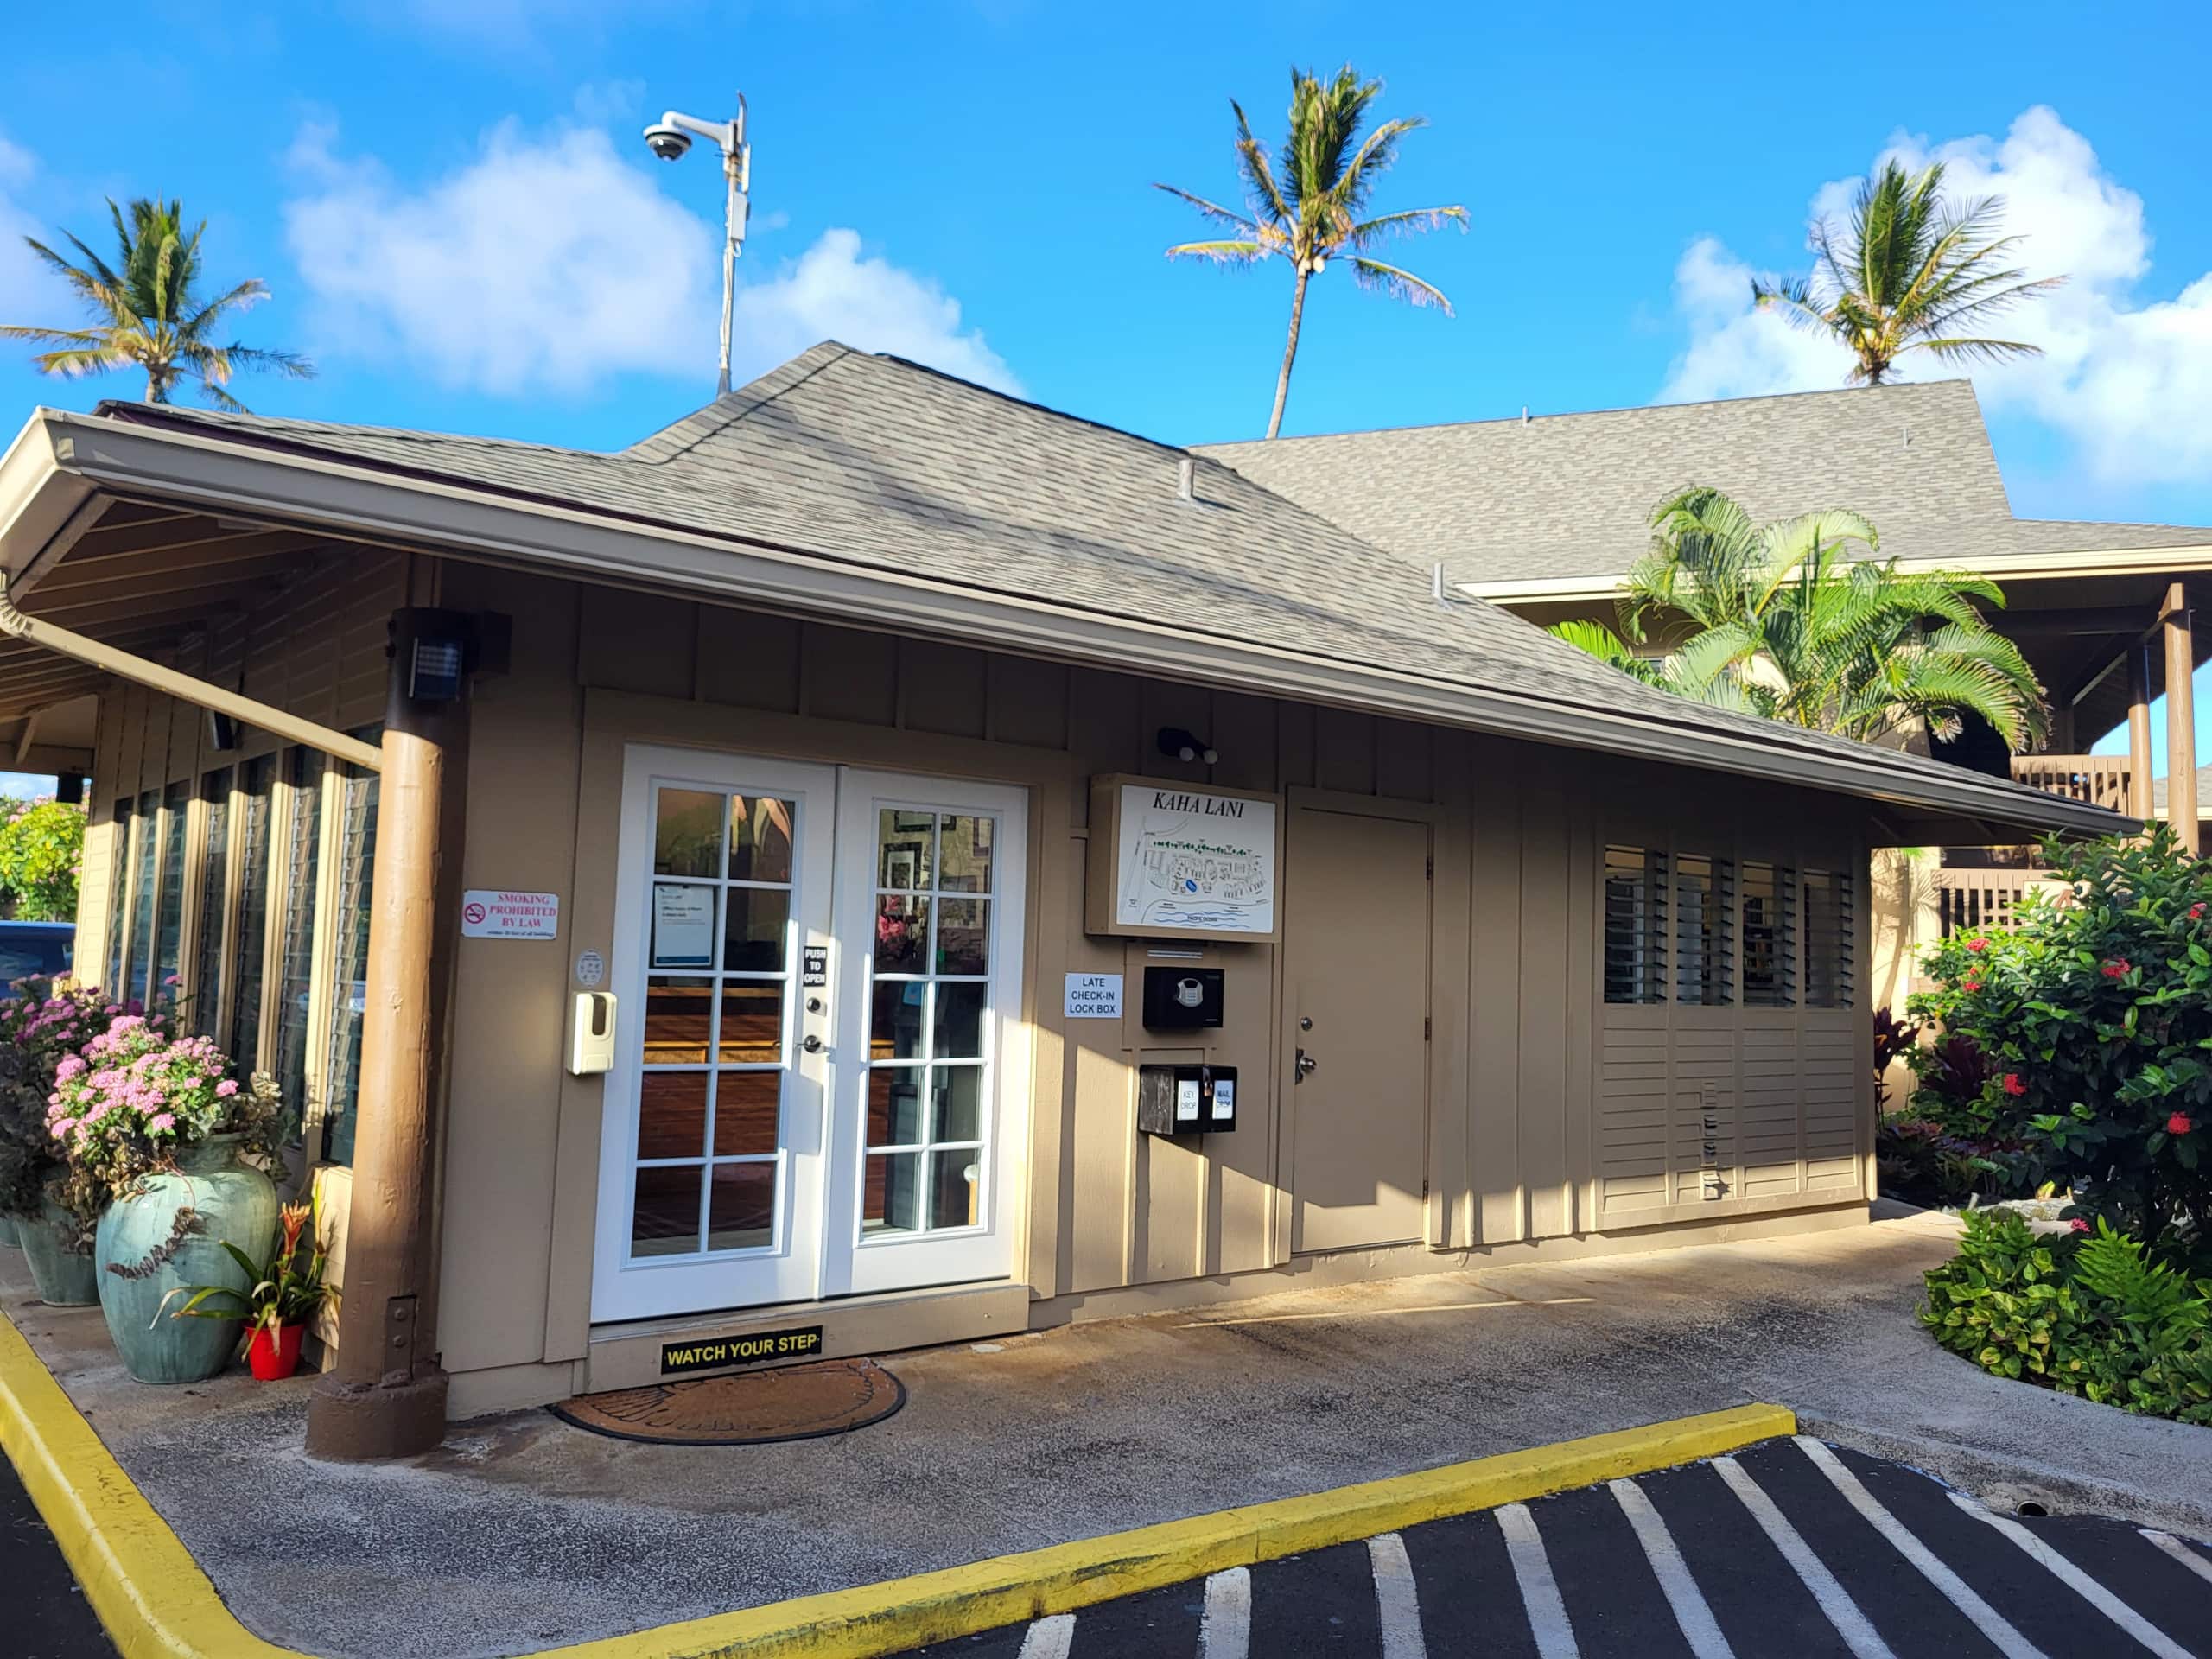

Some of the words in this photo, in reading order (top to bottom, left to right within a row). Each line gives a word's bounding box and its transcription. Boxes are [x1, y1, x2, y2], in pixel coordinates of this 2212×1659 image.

[1153, 792, 1199, 813] KAHA
[1205, 798, 1245, 818] LANI
[498, 893, 550, 905] SMOKING
[489, 905, 556, 917] PROHIBITED
[502, 918, 516, 927] BY
[519, 918, 542, 928] LAW
[805, 949, 826, 959] PUSH
[810, 961, 822, 971] TO
[804, 973, 825, 984] OPEN
[1082, 977, 1106, 988] LATE
[1071, 990, 1115, 1001] CHECK-IN
[1069, 1003, 1094, 1014] LOCK
[1096, 1004, 1116, 1014] BOX
[667, 1344, 727, 1366] WATCH
[729, 1338, 774, 1358] YOUR
[778, 1333, 817, 1352] STEP
